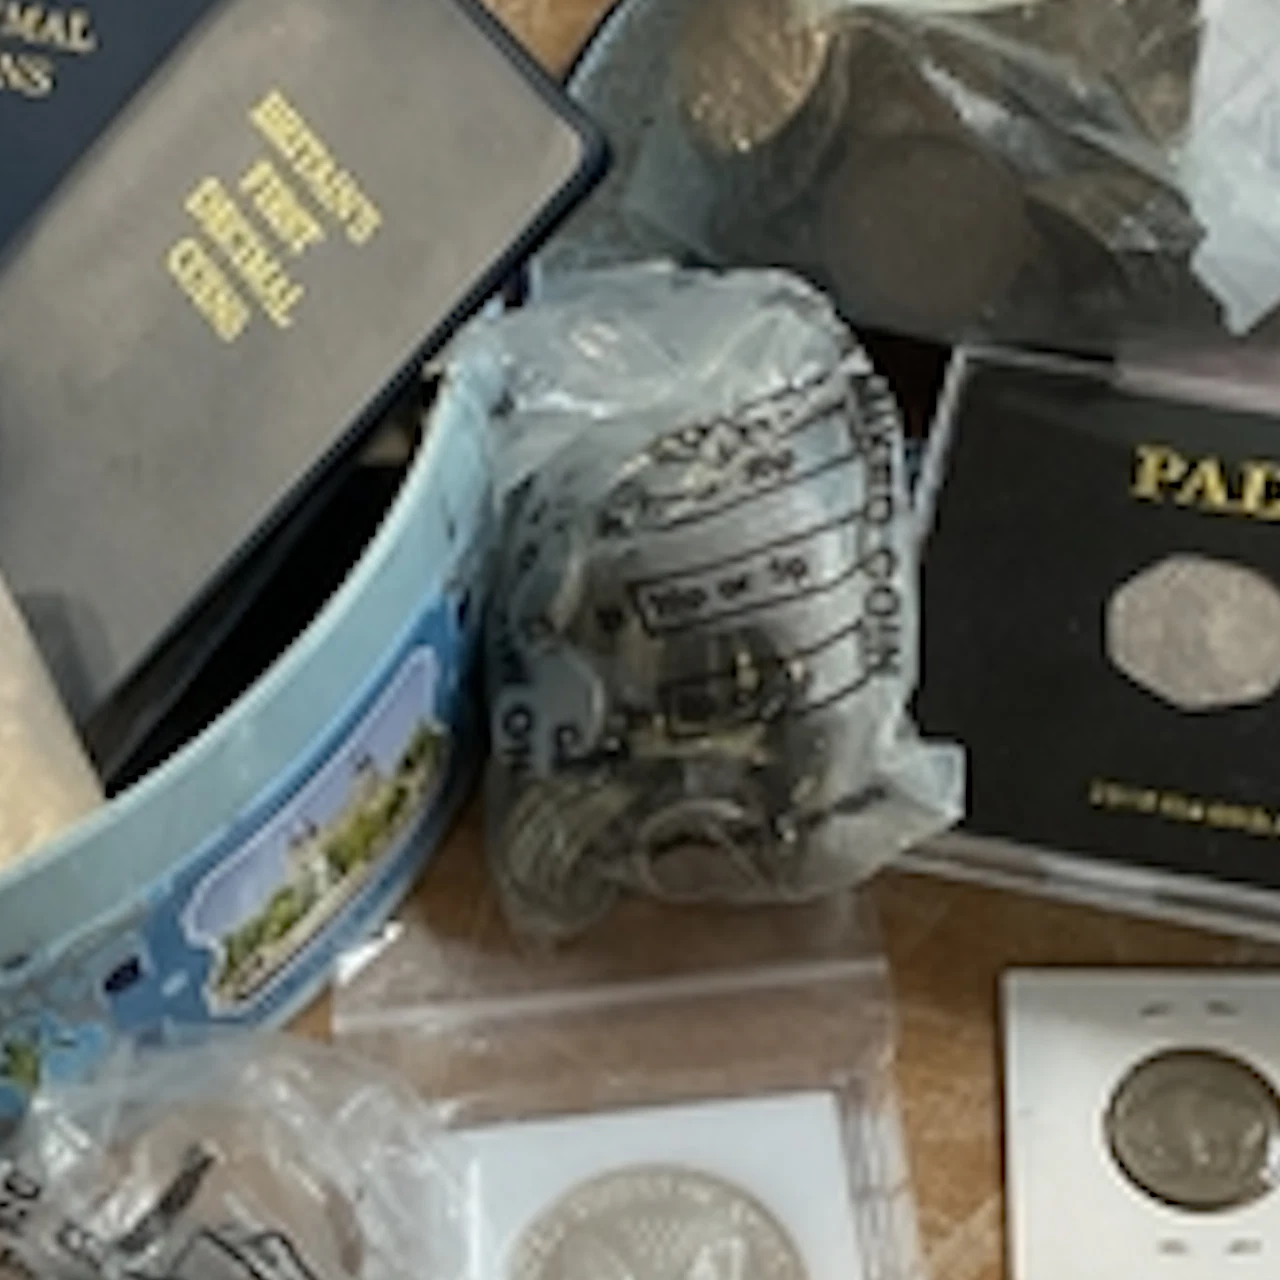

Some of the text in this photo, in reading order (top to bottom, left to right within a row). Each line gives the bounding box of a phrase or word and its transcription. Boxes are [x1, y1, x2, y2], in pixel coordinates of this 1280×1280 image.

[237, 159, 323, 255] FIRST
[248, 89, 383, 245] BRITAIN'S
[166, 237, 251, 344] COINS
[183, 176, 305, 328] DECIMAL
